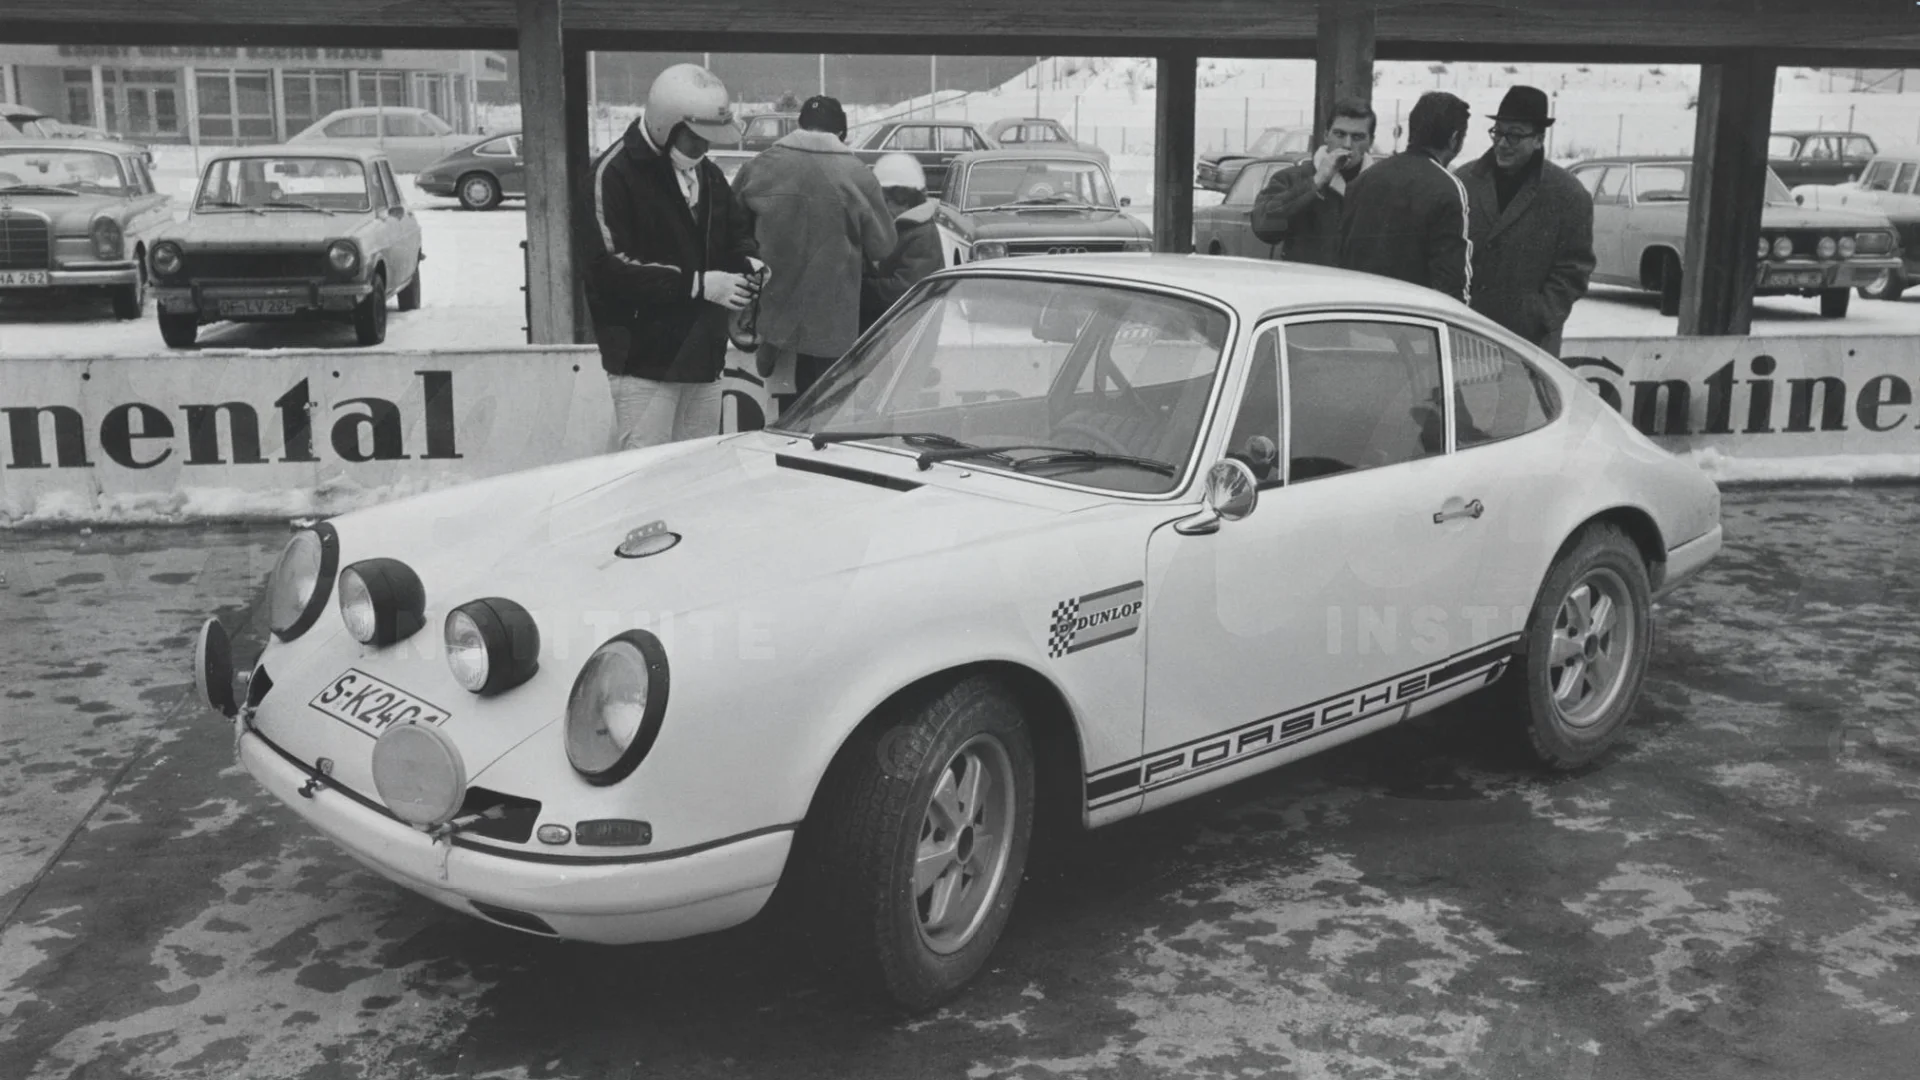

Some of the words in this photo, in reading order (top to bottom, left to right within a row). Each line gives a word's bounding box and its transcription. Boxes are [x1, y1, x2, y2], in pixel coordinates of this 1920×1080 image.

[20, 272, 45, 284] 262
[1, 370, 463, 469] nental
[1560, 356, 1920, 436] ntine
[1077, 601, 1142, 630] DUNLOP
[320, 674, 439, 729] S-K24
[1145, 673, 1427, 783] PORSCHE
